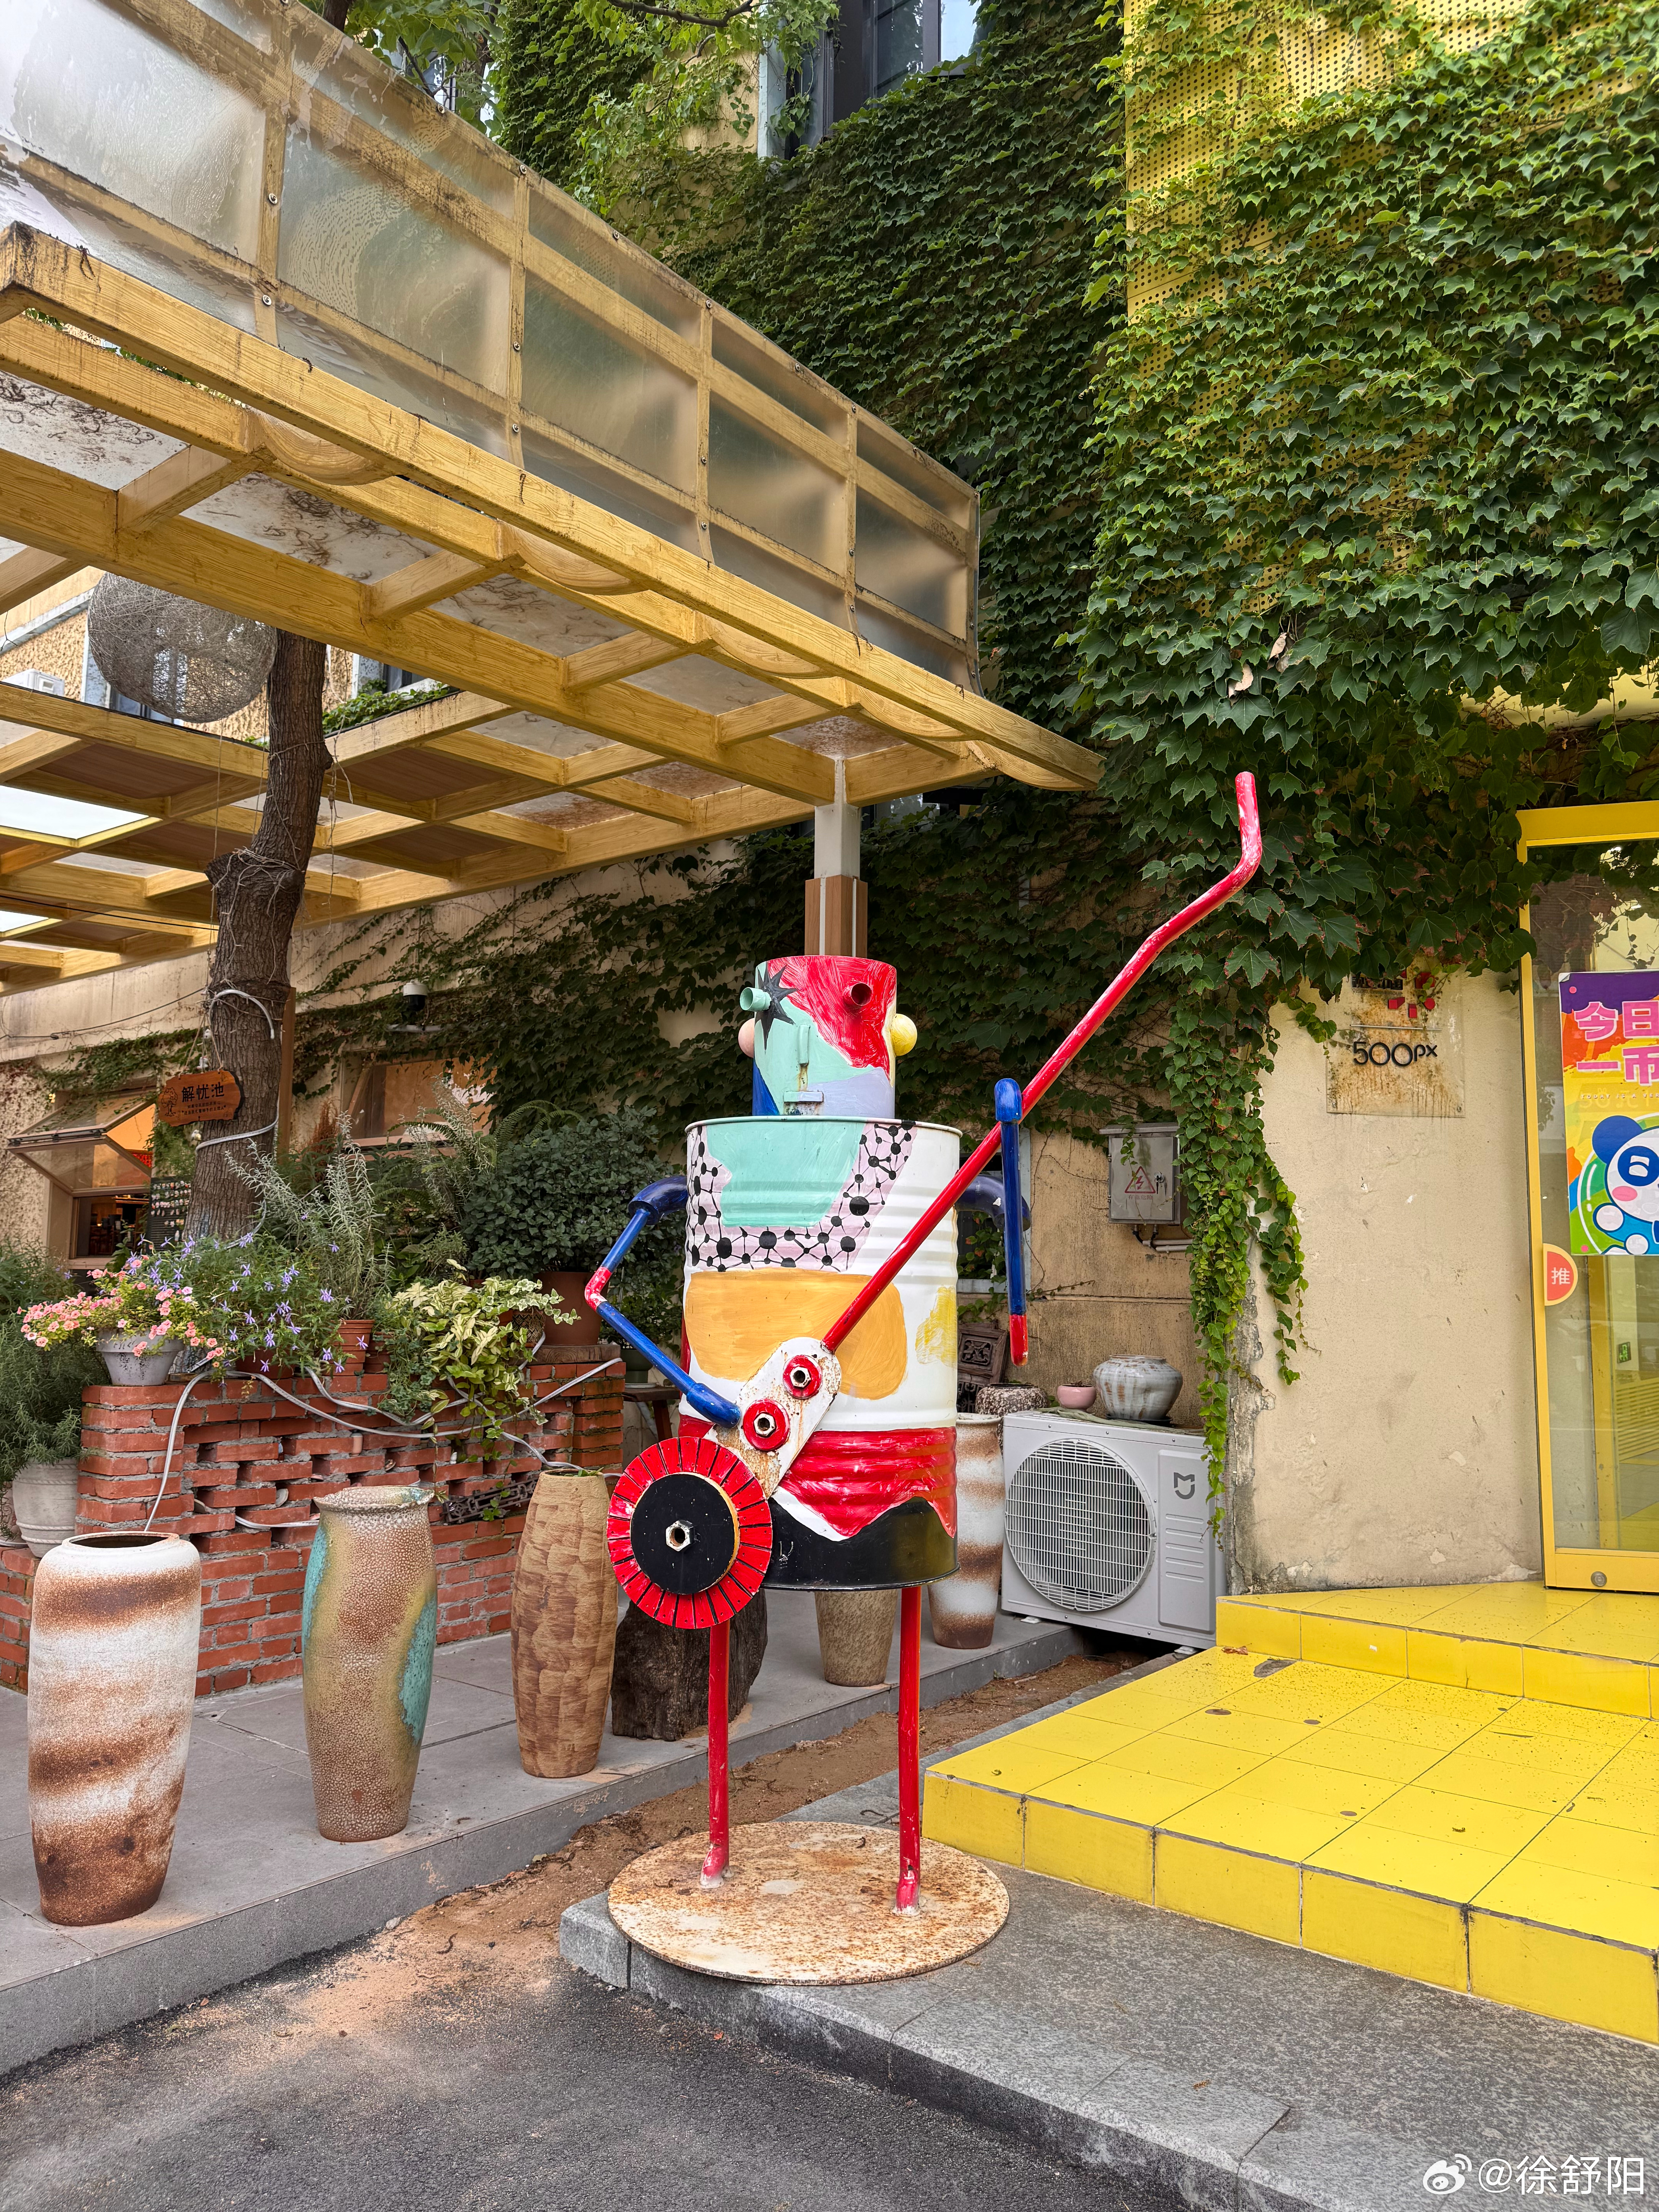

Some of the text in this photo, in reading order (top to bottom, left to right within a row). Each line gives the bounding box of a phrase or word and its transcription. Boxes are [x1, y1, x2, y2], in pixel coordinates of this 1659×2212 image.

[1574, 1000, 1659, 1042] 今日
[1353, 1041, 1438, 1067] 500px
[181, 1082, 225, 1103] 解忧池
[1551, 1267, 1571, 1285] 推
